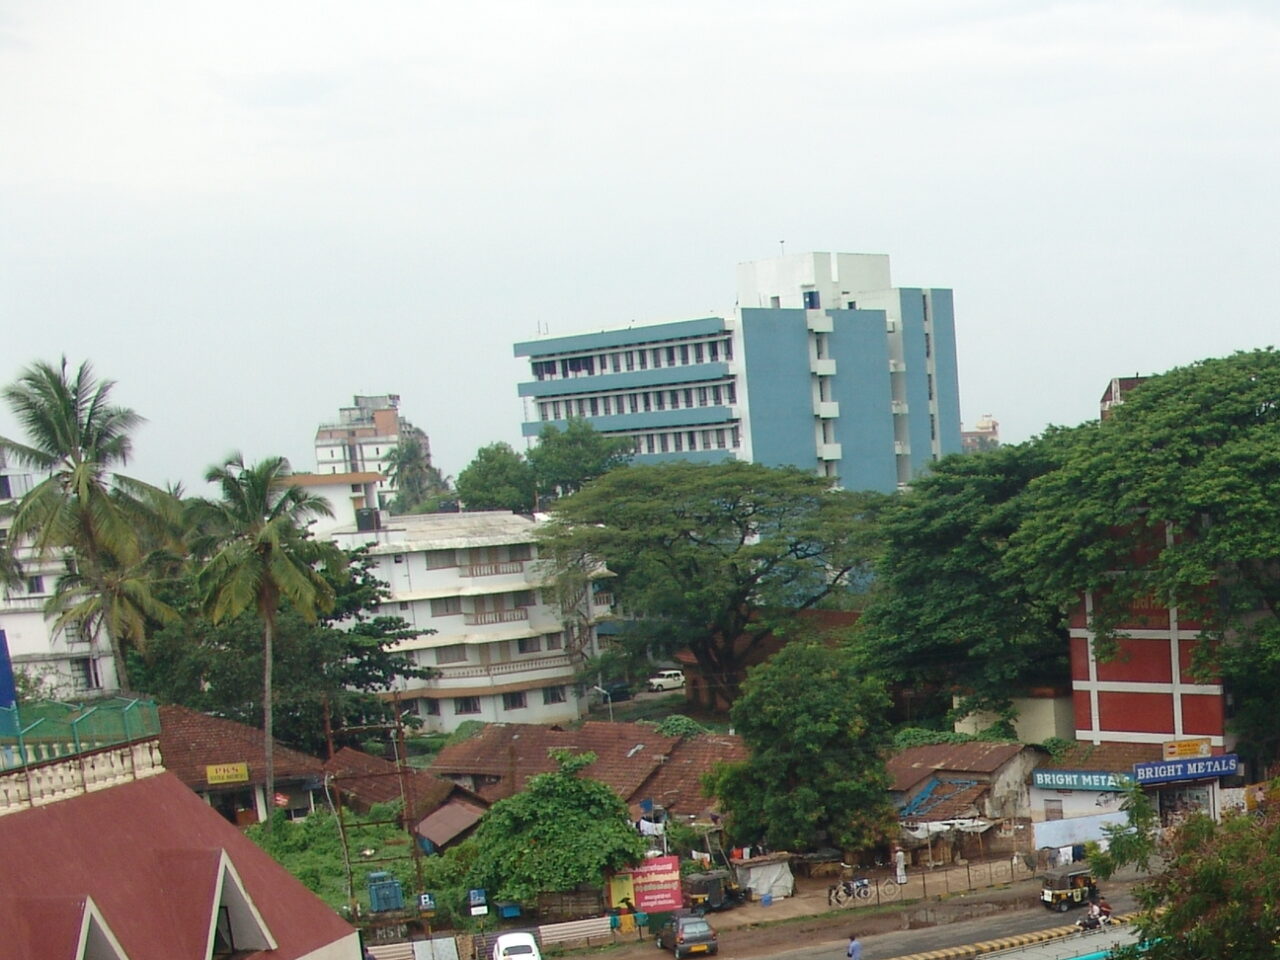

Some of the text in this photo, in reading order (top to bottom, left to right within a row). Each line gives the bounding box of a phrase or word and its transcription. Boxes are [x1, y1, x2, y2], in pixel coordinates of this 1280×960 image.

[1137, 759, 1237, 780] BRIGHT METALS
[1036, 773, 1078, 787] BRIGHT
